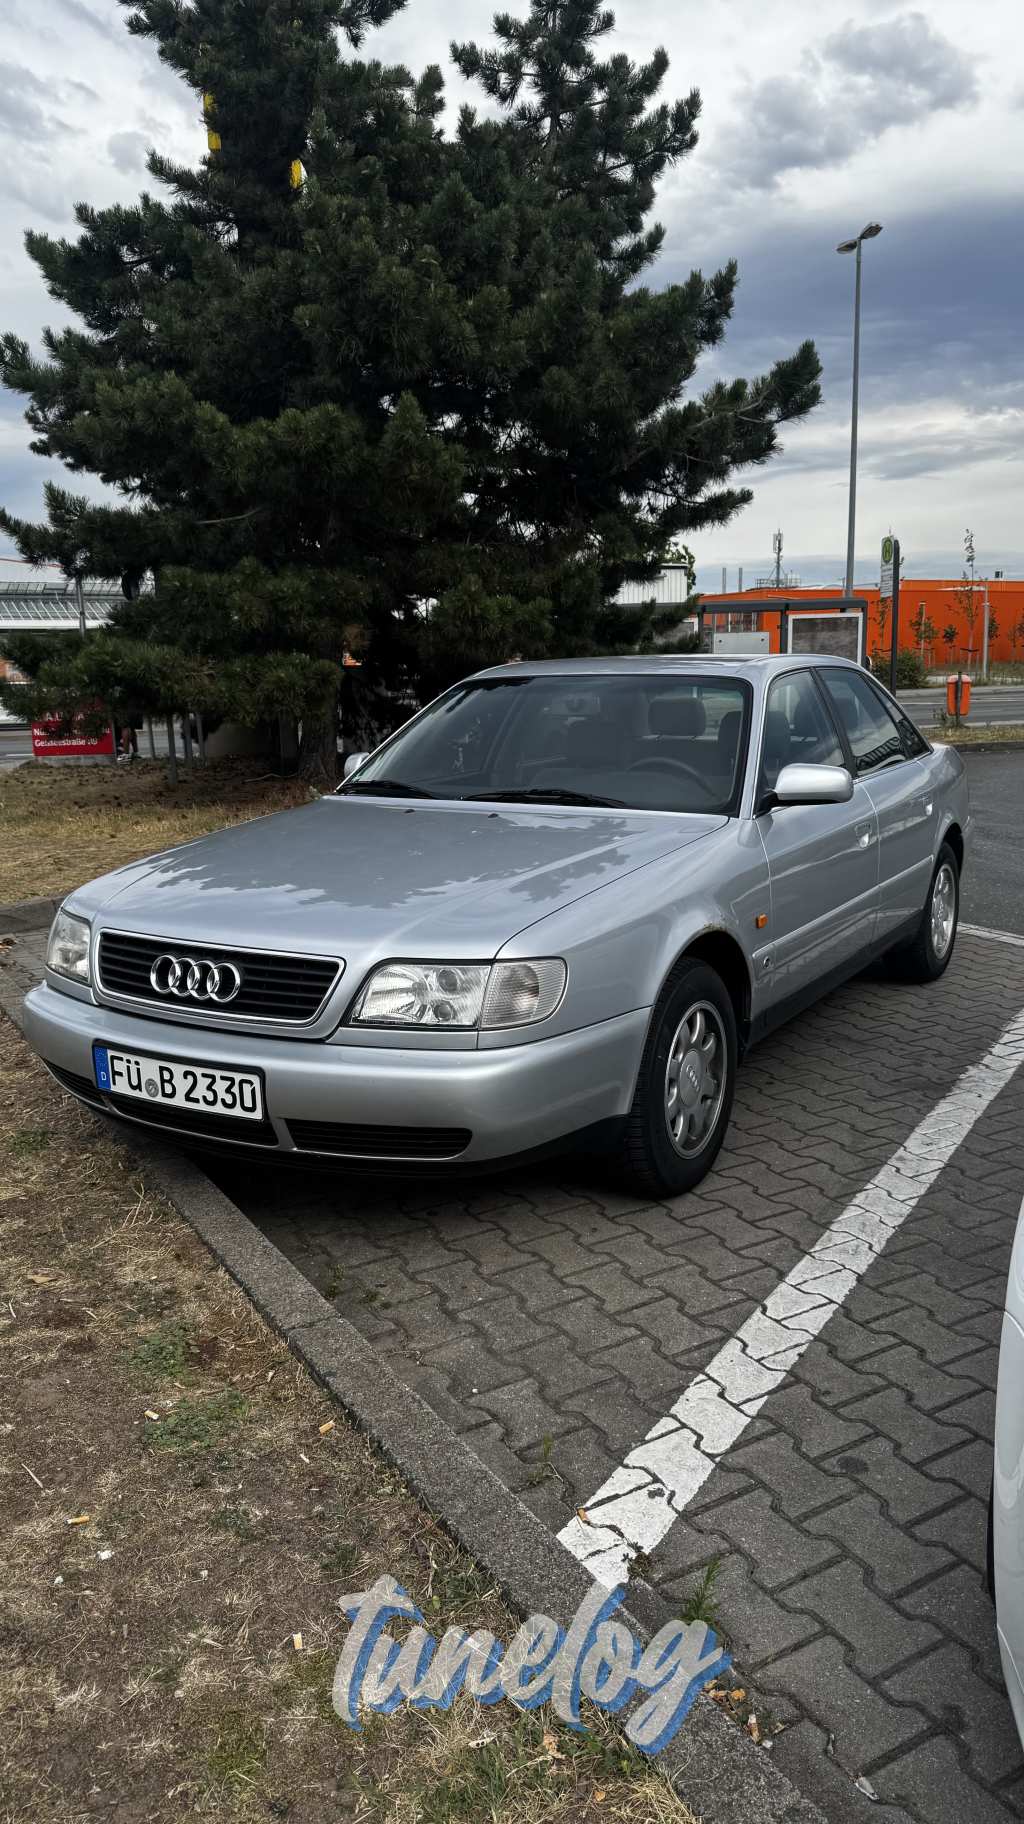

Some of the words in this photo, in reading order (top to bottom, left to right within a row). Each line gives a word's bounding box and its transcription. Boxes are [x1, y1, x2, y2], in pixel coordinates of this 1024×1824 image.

[101, 1071, 107, 1081] D
[109, 1054, 143, 1093] FÜ
[158, 1065, 177, 1099] B
[182, 1070, 257, 1113] 2330
